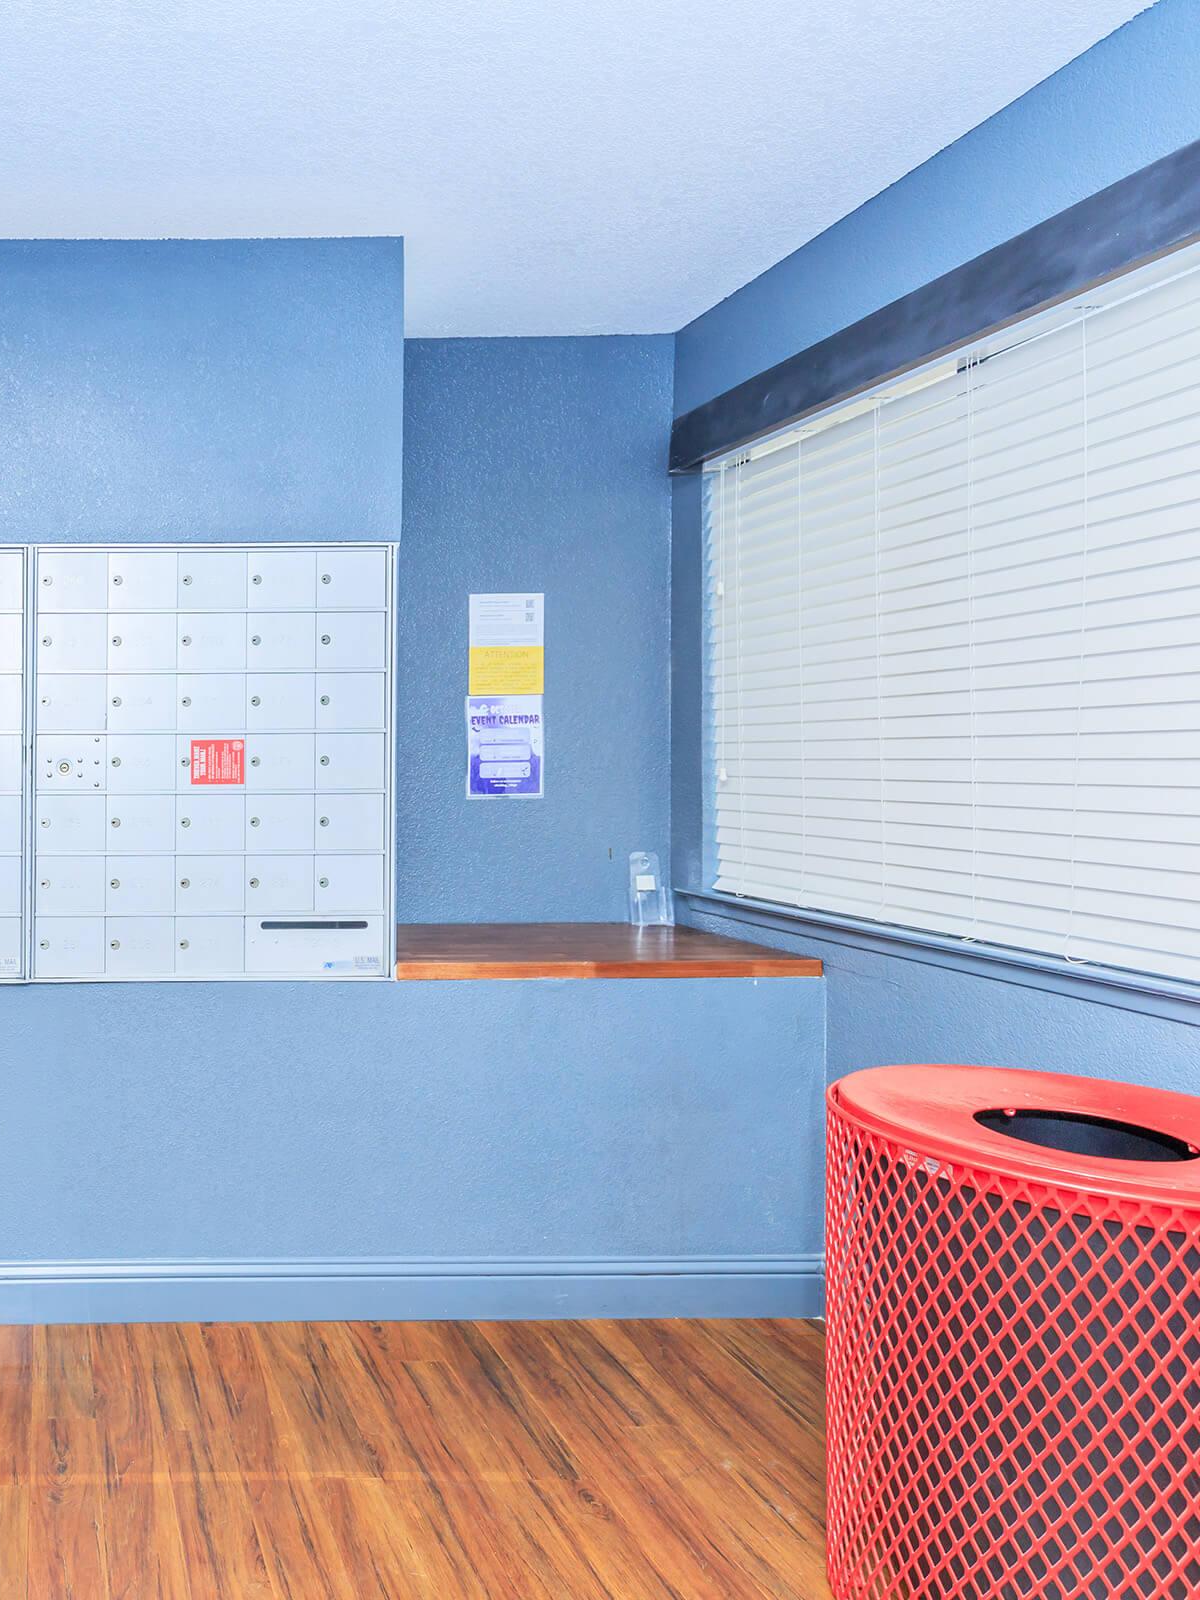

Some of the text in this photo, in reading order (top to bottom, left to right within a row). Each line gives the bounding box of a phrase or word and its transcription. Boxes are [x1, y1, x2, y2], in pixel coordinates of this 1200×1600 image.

[484, 650, 529, 659] ATTENTION
[471, 714, 540, 726] EVENT CALENDAR
